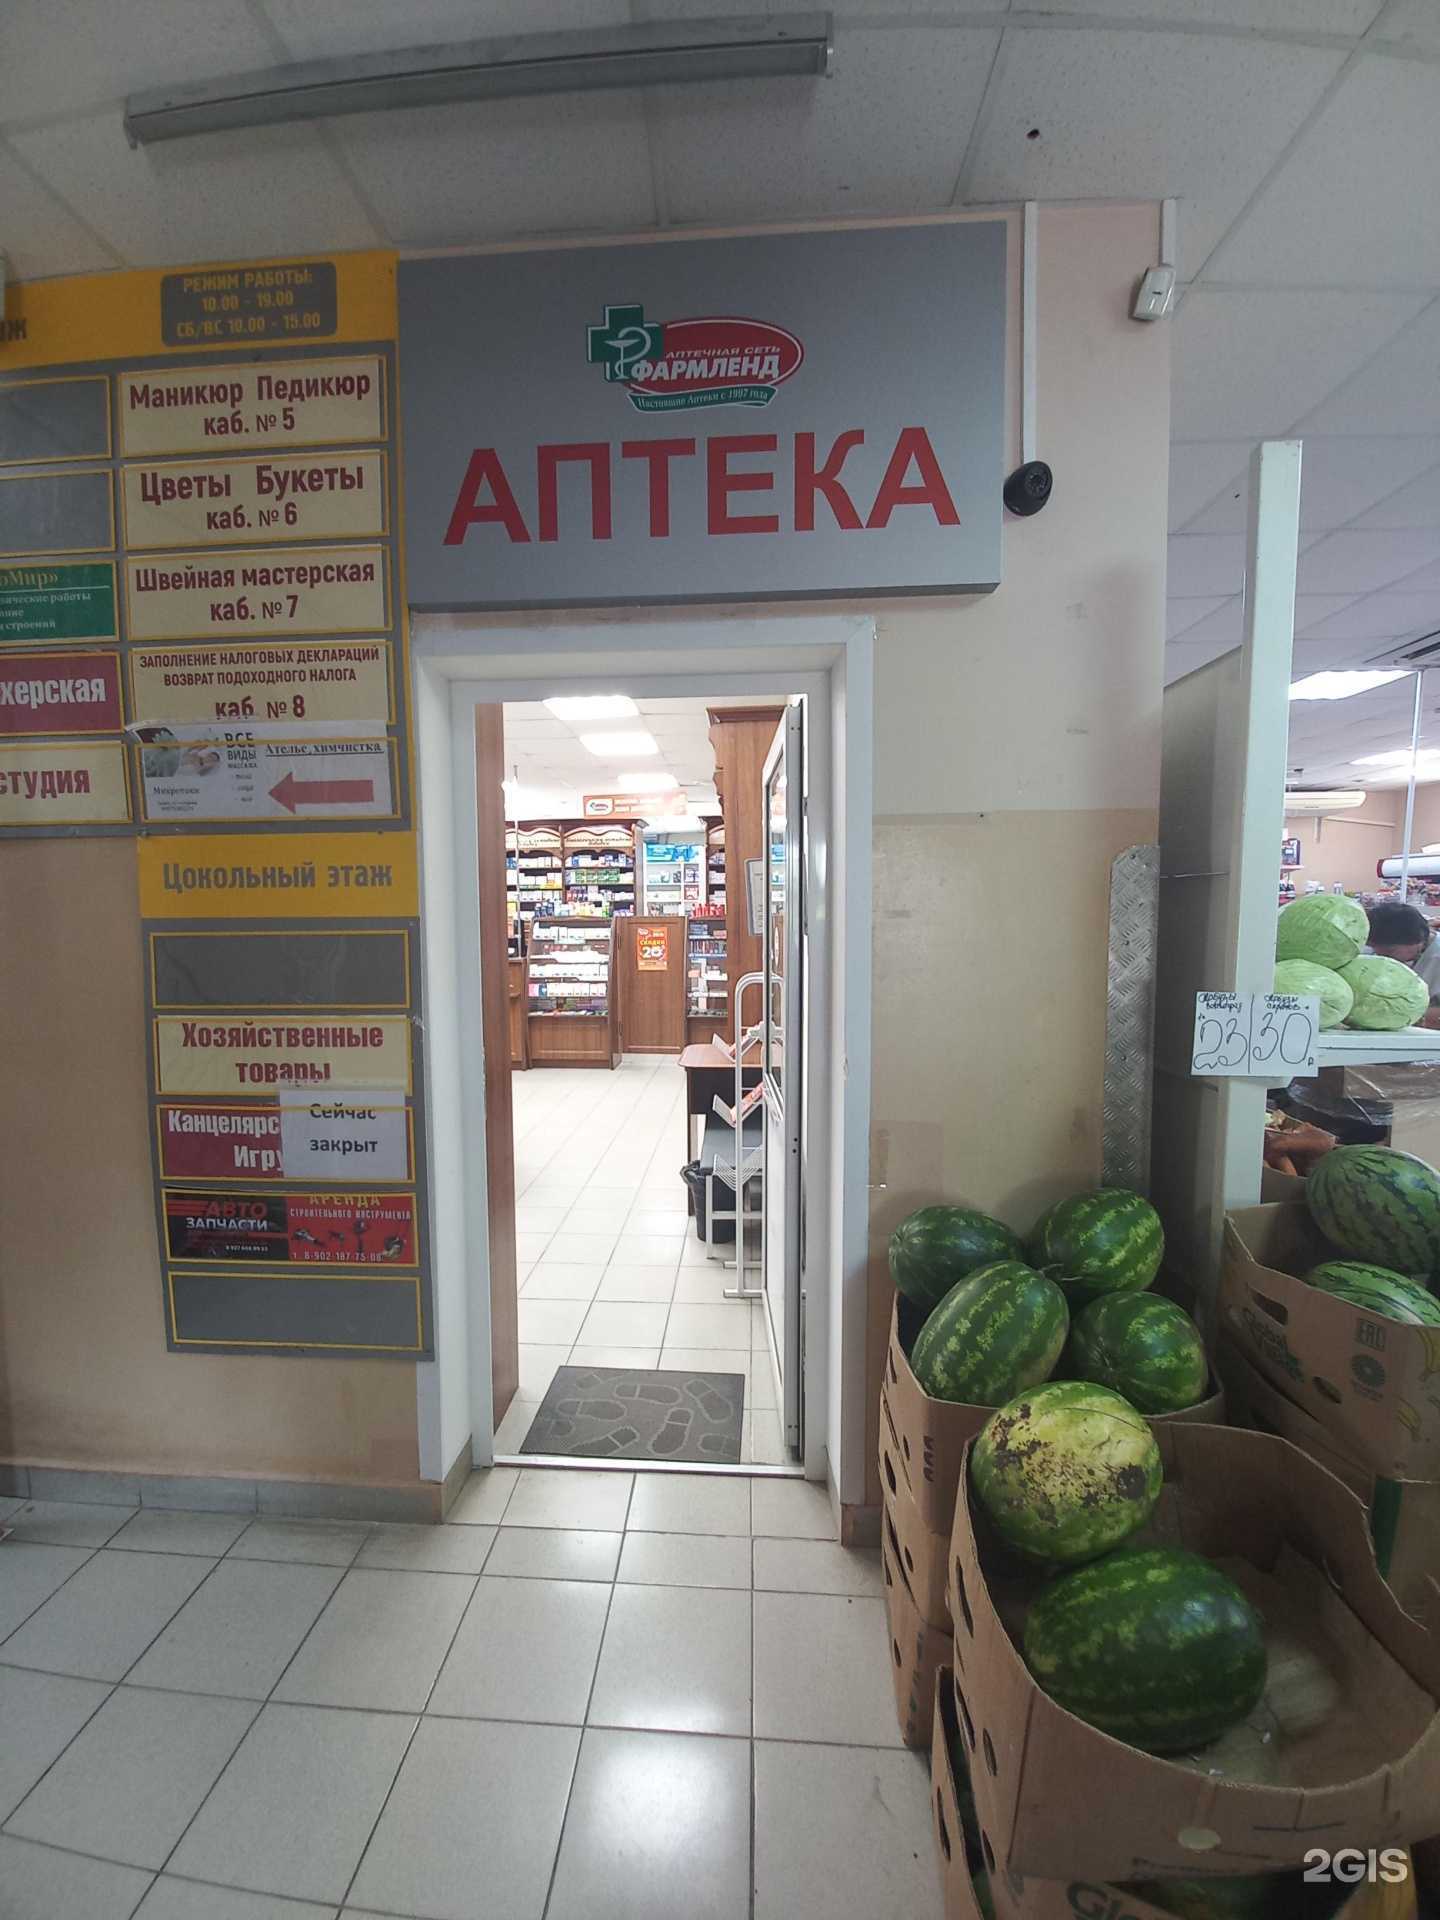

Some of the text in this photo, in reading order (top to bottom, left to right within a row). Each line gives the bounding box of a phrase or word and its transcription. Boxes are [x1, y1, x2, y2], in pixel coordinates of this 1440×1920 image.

[183, 272, 239, 293] РЕЖИМ
[202, 294, 240, 313] 10.00
[257, 290, 294, 308] 19.00
[665, 345, 781, 360] АПТЕЧНАЯ СЕТЬ
[631, 354, 781, 382] ФАРМЛЕНД
[130, 373, 371, 411] Маникюр Педикюр
[204, 411, 250, 436] каб.
[140, 464, 364, 505] Цветы Букеты
[442, 426, 962, 546] АПТЕКА
[207, 505, 252, 530] каб.
[135, 561, 375, 592] Швейная мастерская
[210, 596, 255, 622] каб.
[140, 645, 379, 668] ЗАПОЛНЕНИЕ НАЛОГОВЫХ ДЕКЛАРАЦИЙ
[164, 668, 356, 687] ВОЗВРАТ ПОДОХОДНОГО НАЛОГА
[224, 733, 256, 748] ВСЕ
[228, 749, 257, 762] ВИДЫ
[163, 861, 393, 893] Цокольный этаж
[182, 1021, 384, 1048] Хозяйственные
[310, 1102, 377, 1120] Сейчас
[309, 1138, 378, 1156] закрыт
[204, 1201, 268, 1217] АВТО
[185, 1216, 268, 1231] ЗАПЧАСТИ
